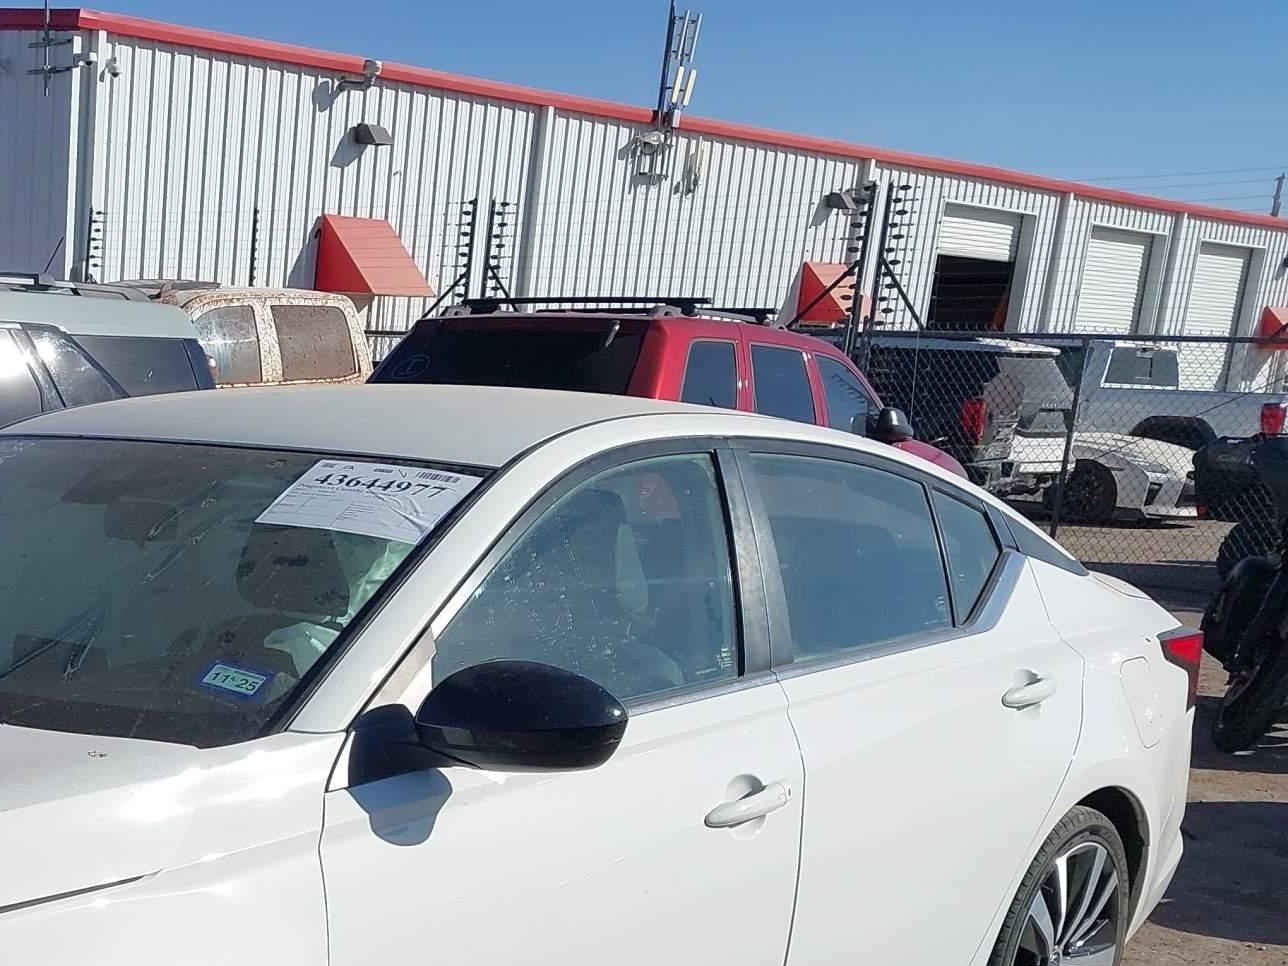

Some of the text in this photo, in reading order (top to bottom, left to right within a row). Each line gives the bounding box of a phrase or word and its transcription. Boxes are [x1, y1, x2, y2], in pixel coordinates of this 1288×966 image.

[314, 472, 449, 499] 43644977
[211, 671, 231, 684] 11
[235, 678, 260, 692] 25
